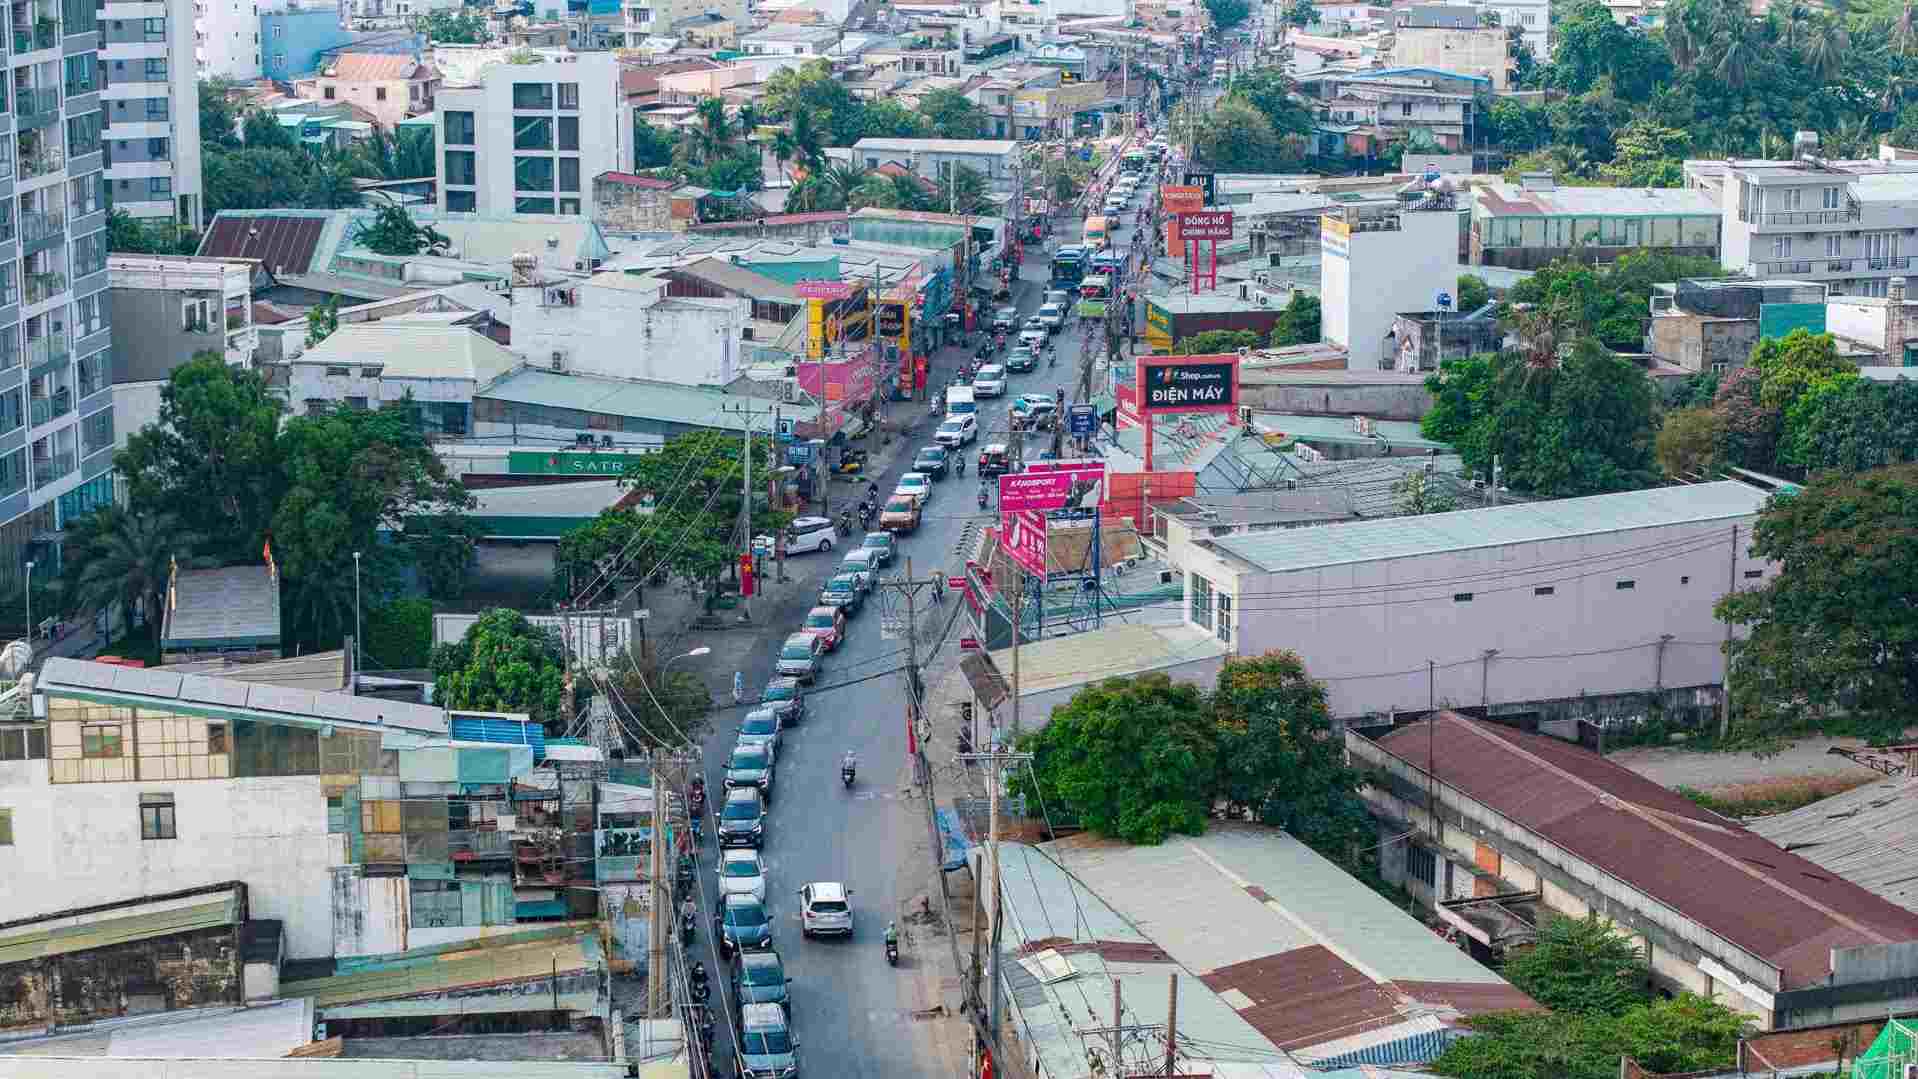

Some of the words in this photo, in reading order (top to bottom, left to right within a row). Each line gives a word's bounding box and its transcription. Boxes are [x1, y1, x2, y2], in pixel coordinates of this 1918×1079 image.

[1152, 386, 1188, 404] ĐIỆN
[1192, 384, 1225, 401] MÁY
[573, 460, 624, 472] SATR
